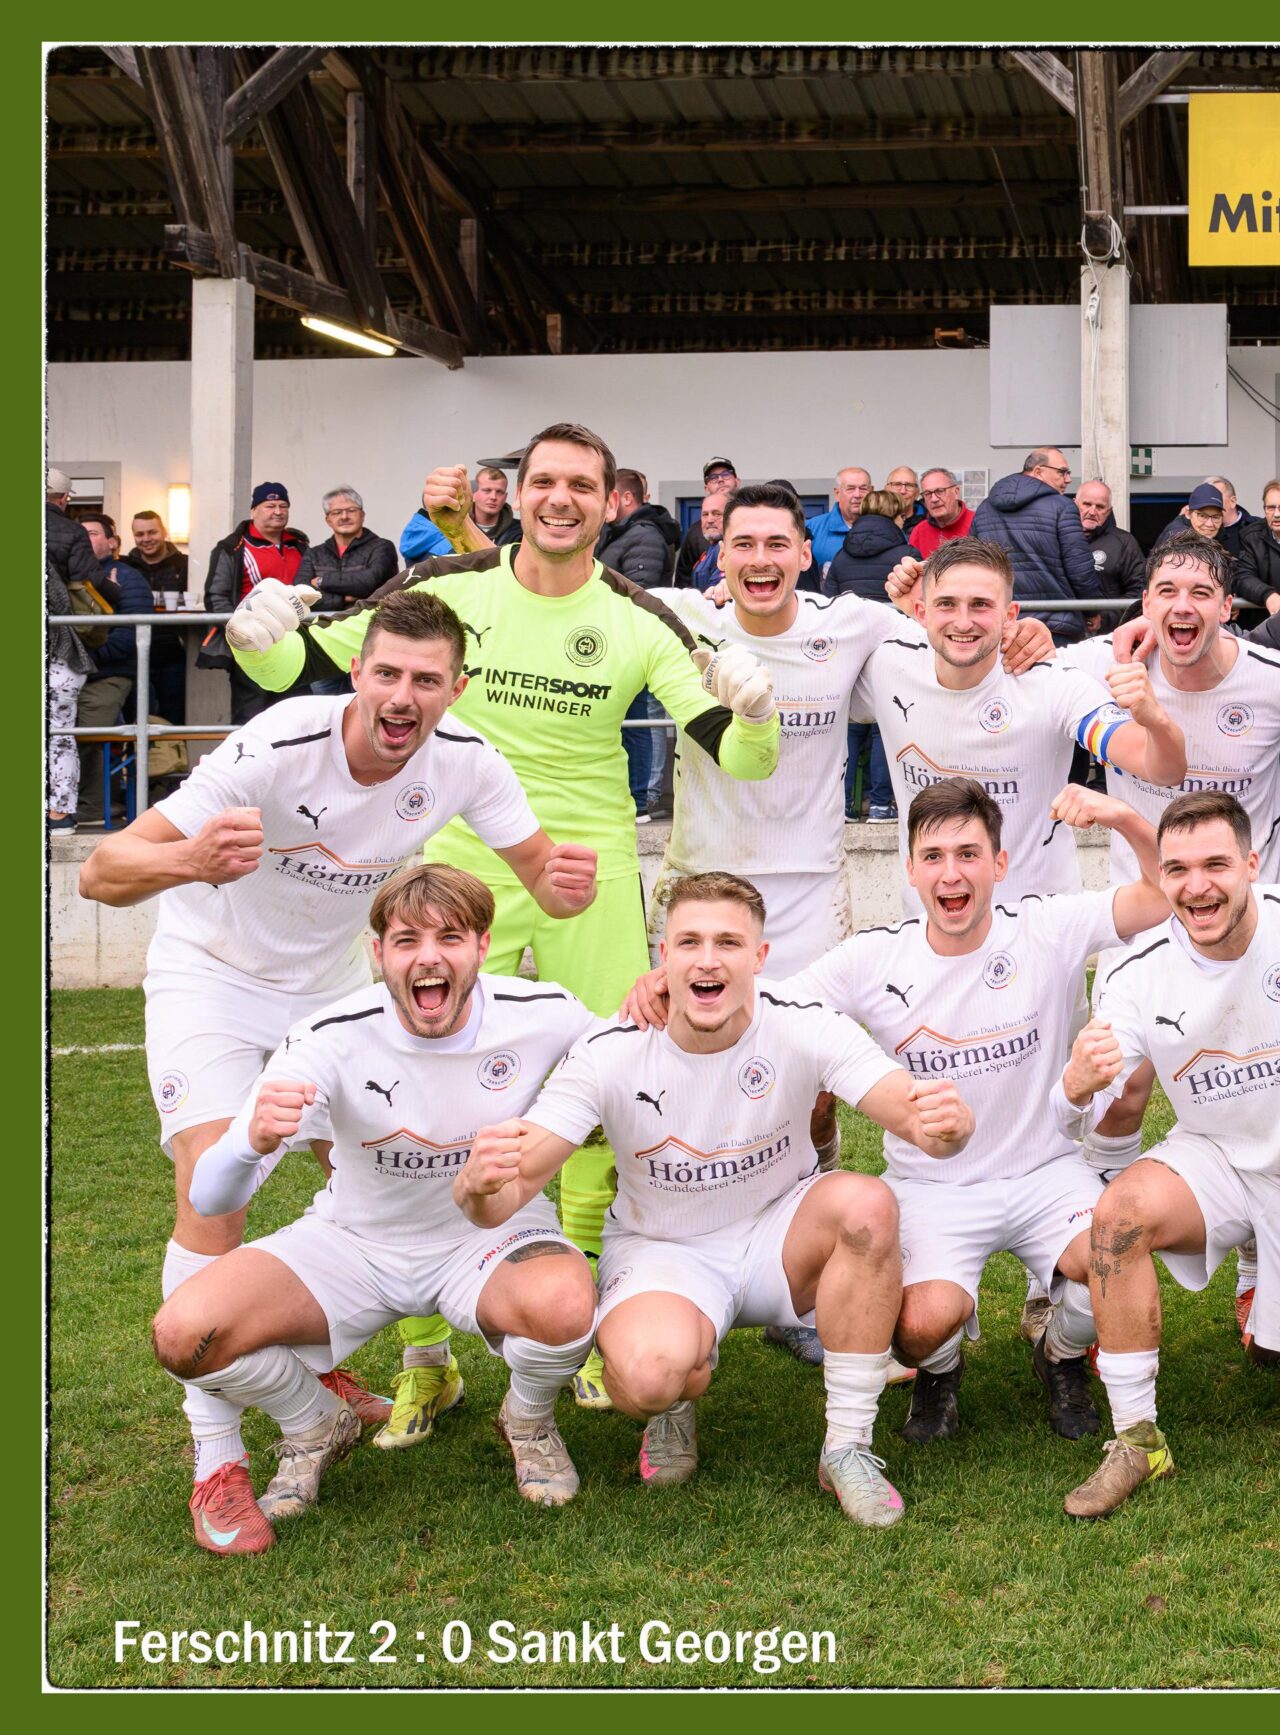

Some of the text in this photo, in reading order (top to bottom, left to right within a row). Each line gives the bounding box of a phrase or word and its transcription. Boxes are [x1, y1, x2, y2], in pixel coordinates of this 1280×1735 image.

[485, 668, 612, 700] INTERSPORT
[486, 689, 592, 717] WINNINGER
[904, 1028, 1040, 1073] Hörmann
[1260, 1040, 1280, 1051] Dach
[646, 1134, 791, 1183] Hörmann
